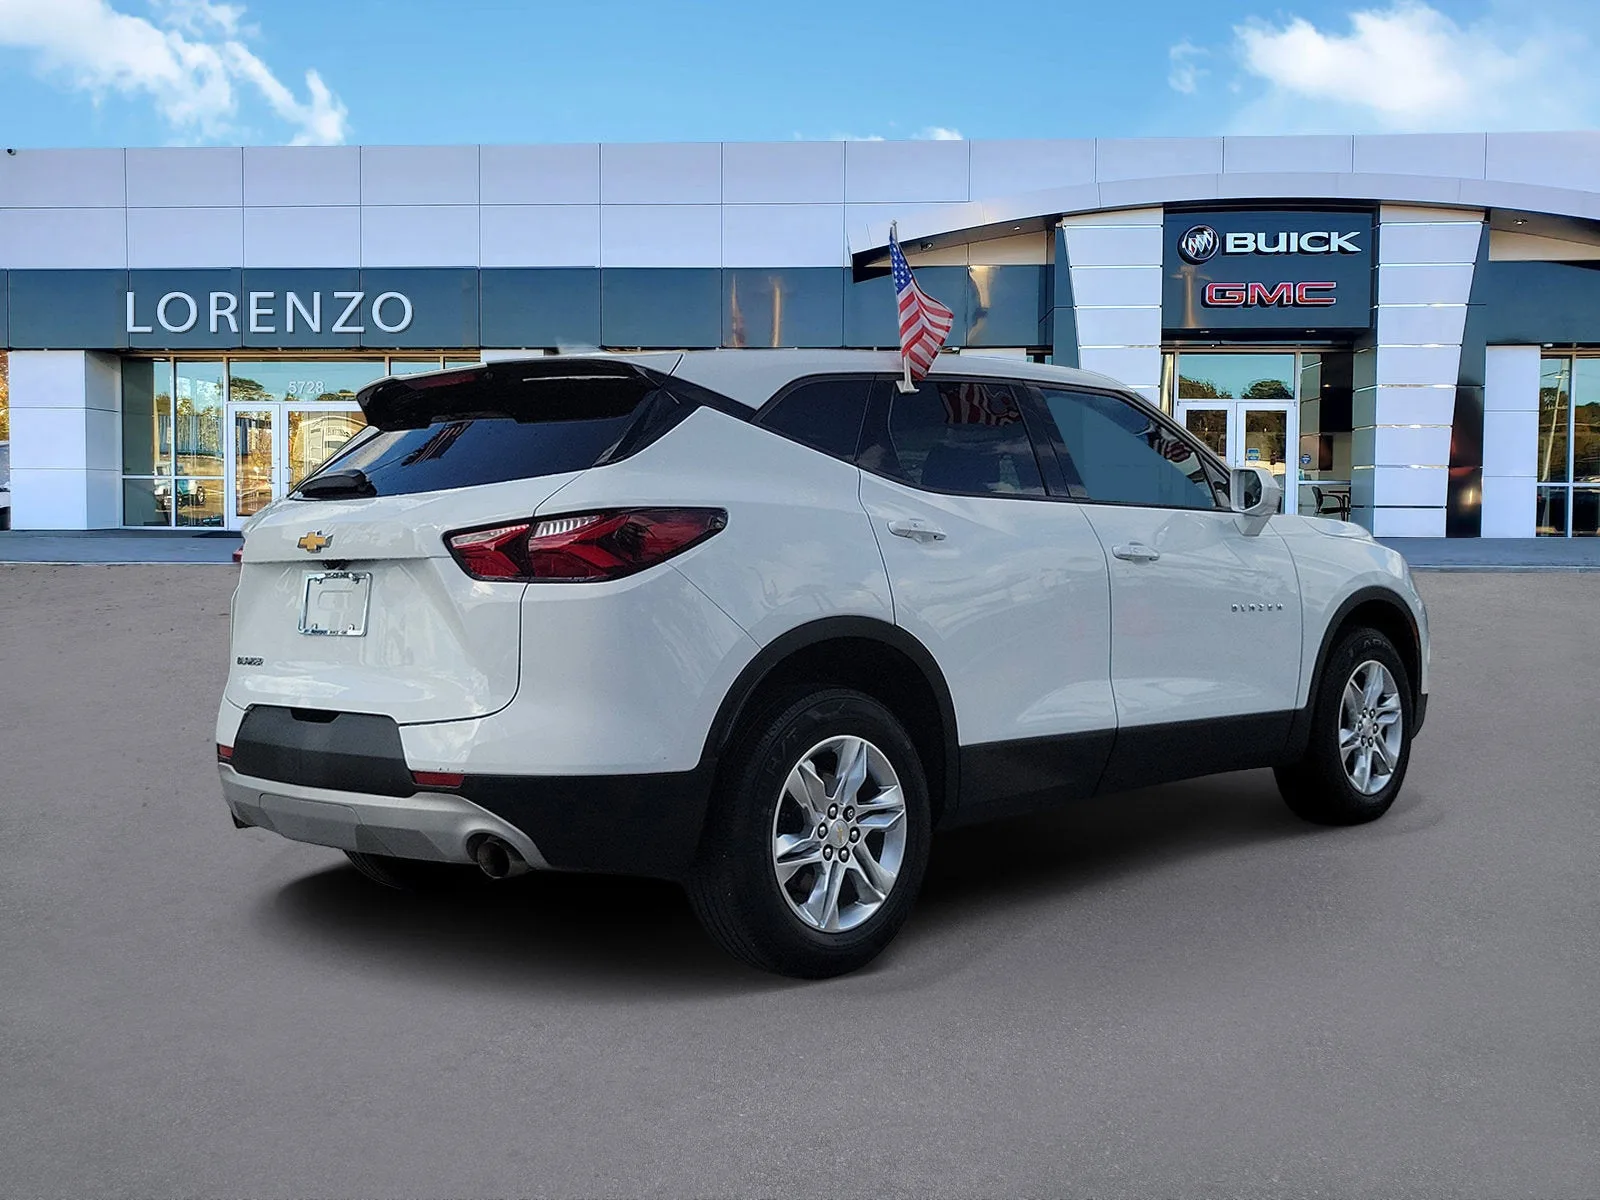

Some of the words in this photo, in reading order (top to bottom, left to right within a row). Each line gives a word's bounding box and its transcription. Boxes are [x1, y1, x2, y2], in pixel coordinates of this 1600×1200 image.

[1225, 231, 1362, 253] BUICK
[1205, 281, 1337, 305] GMC
[126, 291, 413, 333] LORENZO
[288, 380, 325, 394] 5728
